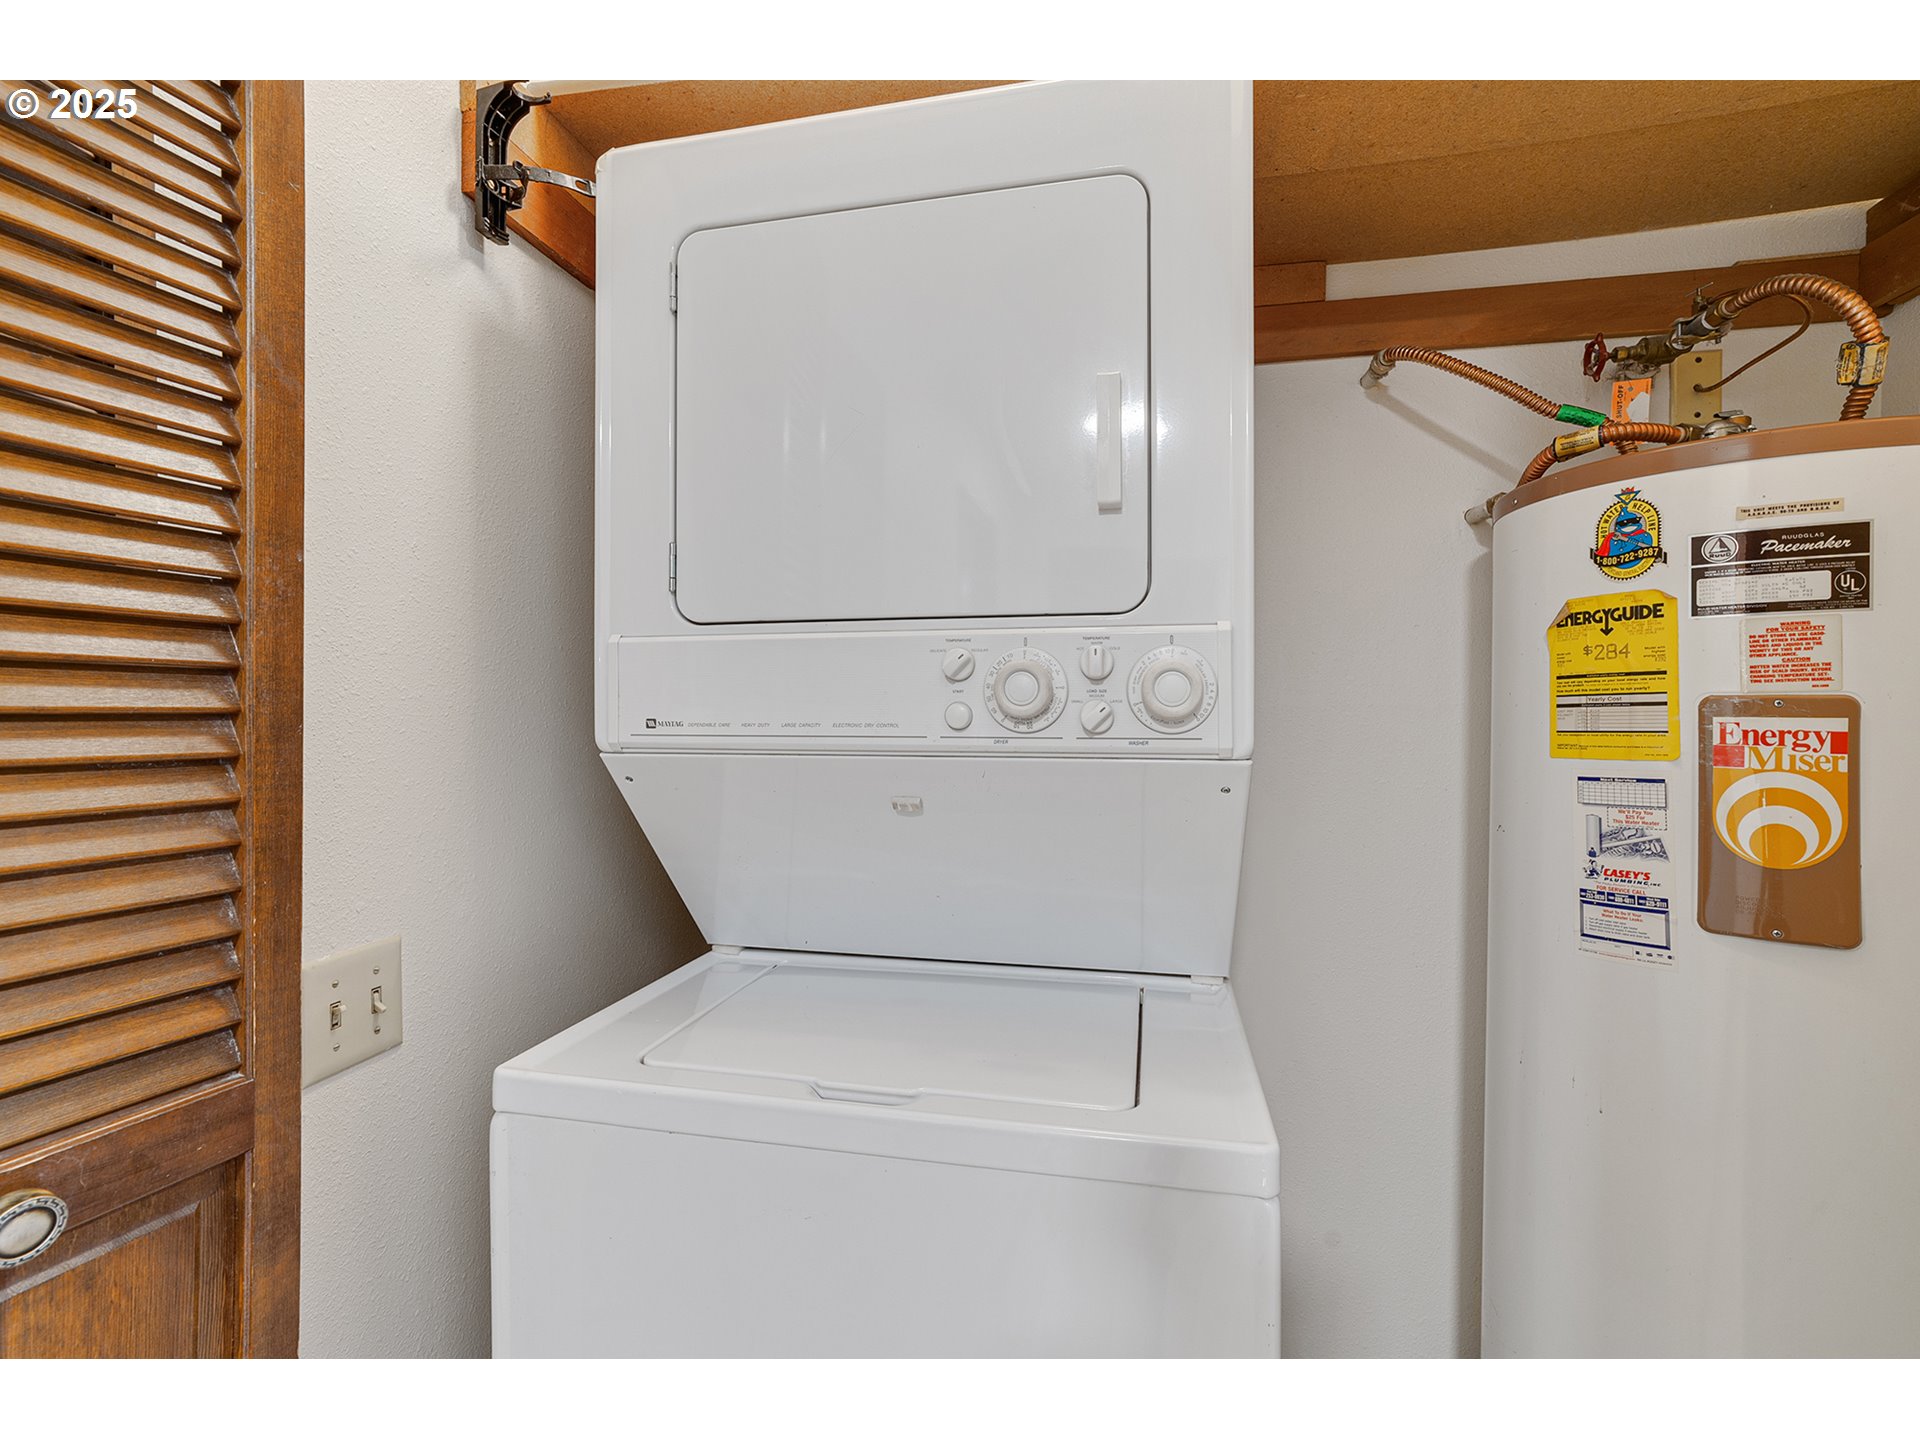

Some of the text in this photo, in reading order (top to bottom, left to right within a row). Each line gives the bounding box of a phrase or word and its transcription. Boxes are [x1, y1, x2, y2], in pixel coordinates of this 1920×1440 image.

[1616, 384, 1624, 418] SHUT-OFF
[1603, 504, 1623, 525] WATER
[1632, 502, 1650, 515] HELP
[1648, 514, 1656, 532] LINE
[1760, 535, 1852, 554] Pacemaker
[1596, 548, 1659, 566] 1-800-722-9287
[1840, 574, 1860, 591] UL
[1556, 602, 1664, 629] ENERGYGUIDE
[1582, 643, 1630, 661] $284
[1717, 721, 1831, 753] Energy
[1750, 746, 1846, 772] Miser
[1603, 868, 1651, 881] CASEY'S
